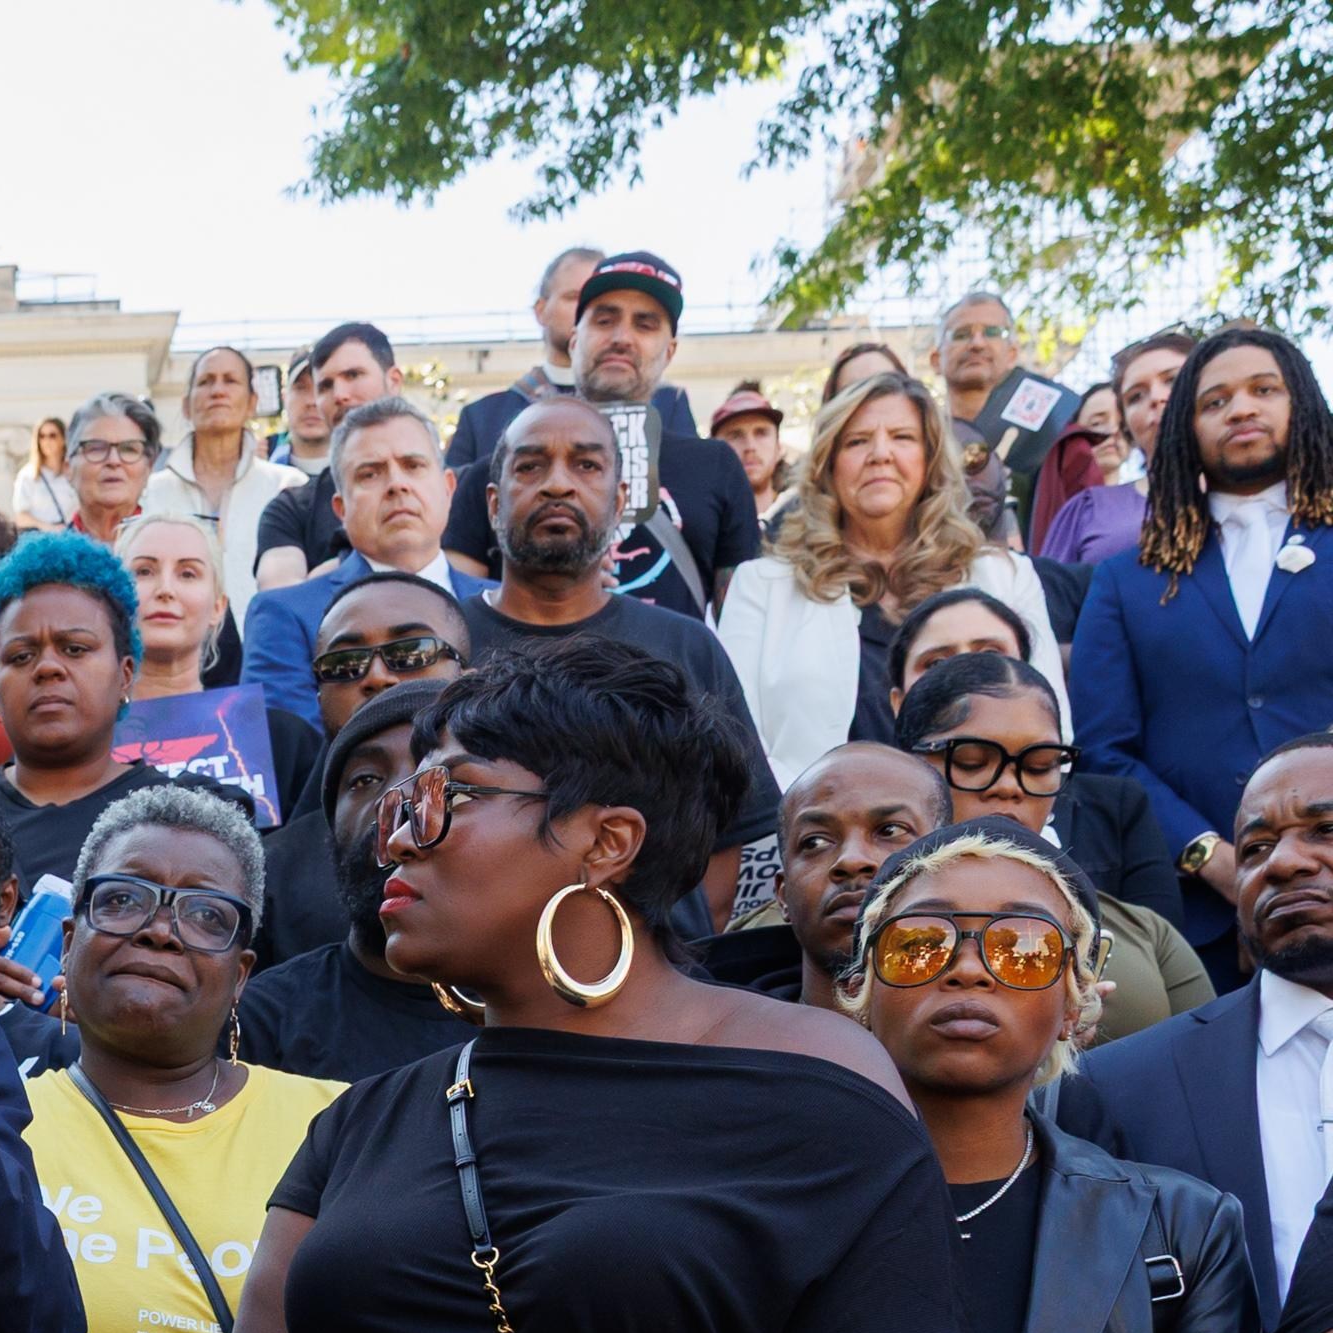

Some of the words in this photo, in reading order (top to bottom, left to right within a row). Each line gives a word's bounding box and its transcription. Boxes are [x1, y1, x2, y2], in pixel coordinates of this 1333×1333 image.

[611, 413, 647, 447] CK
[136, 1227, 260, 1284] Peo
[138, 1309, 198, 1331] POWER
